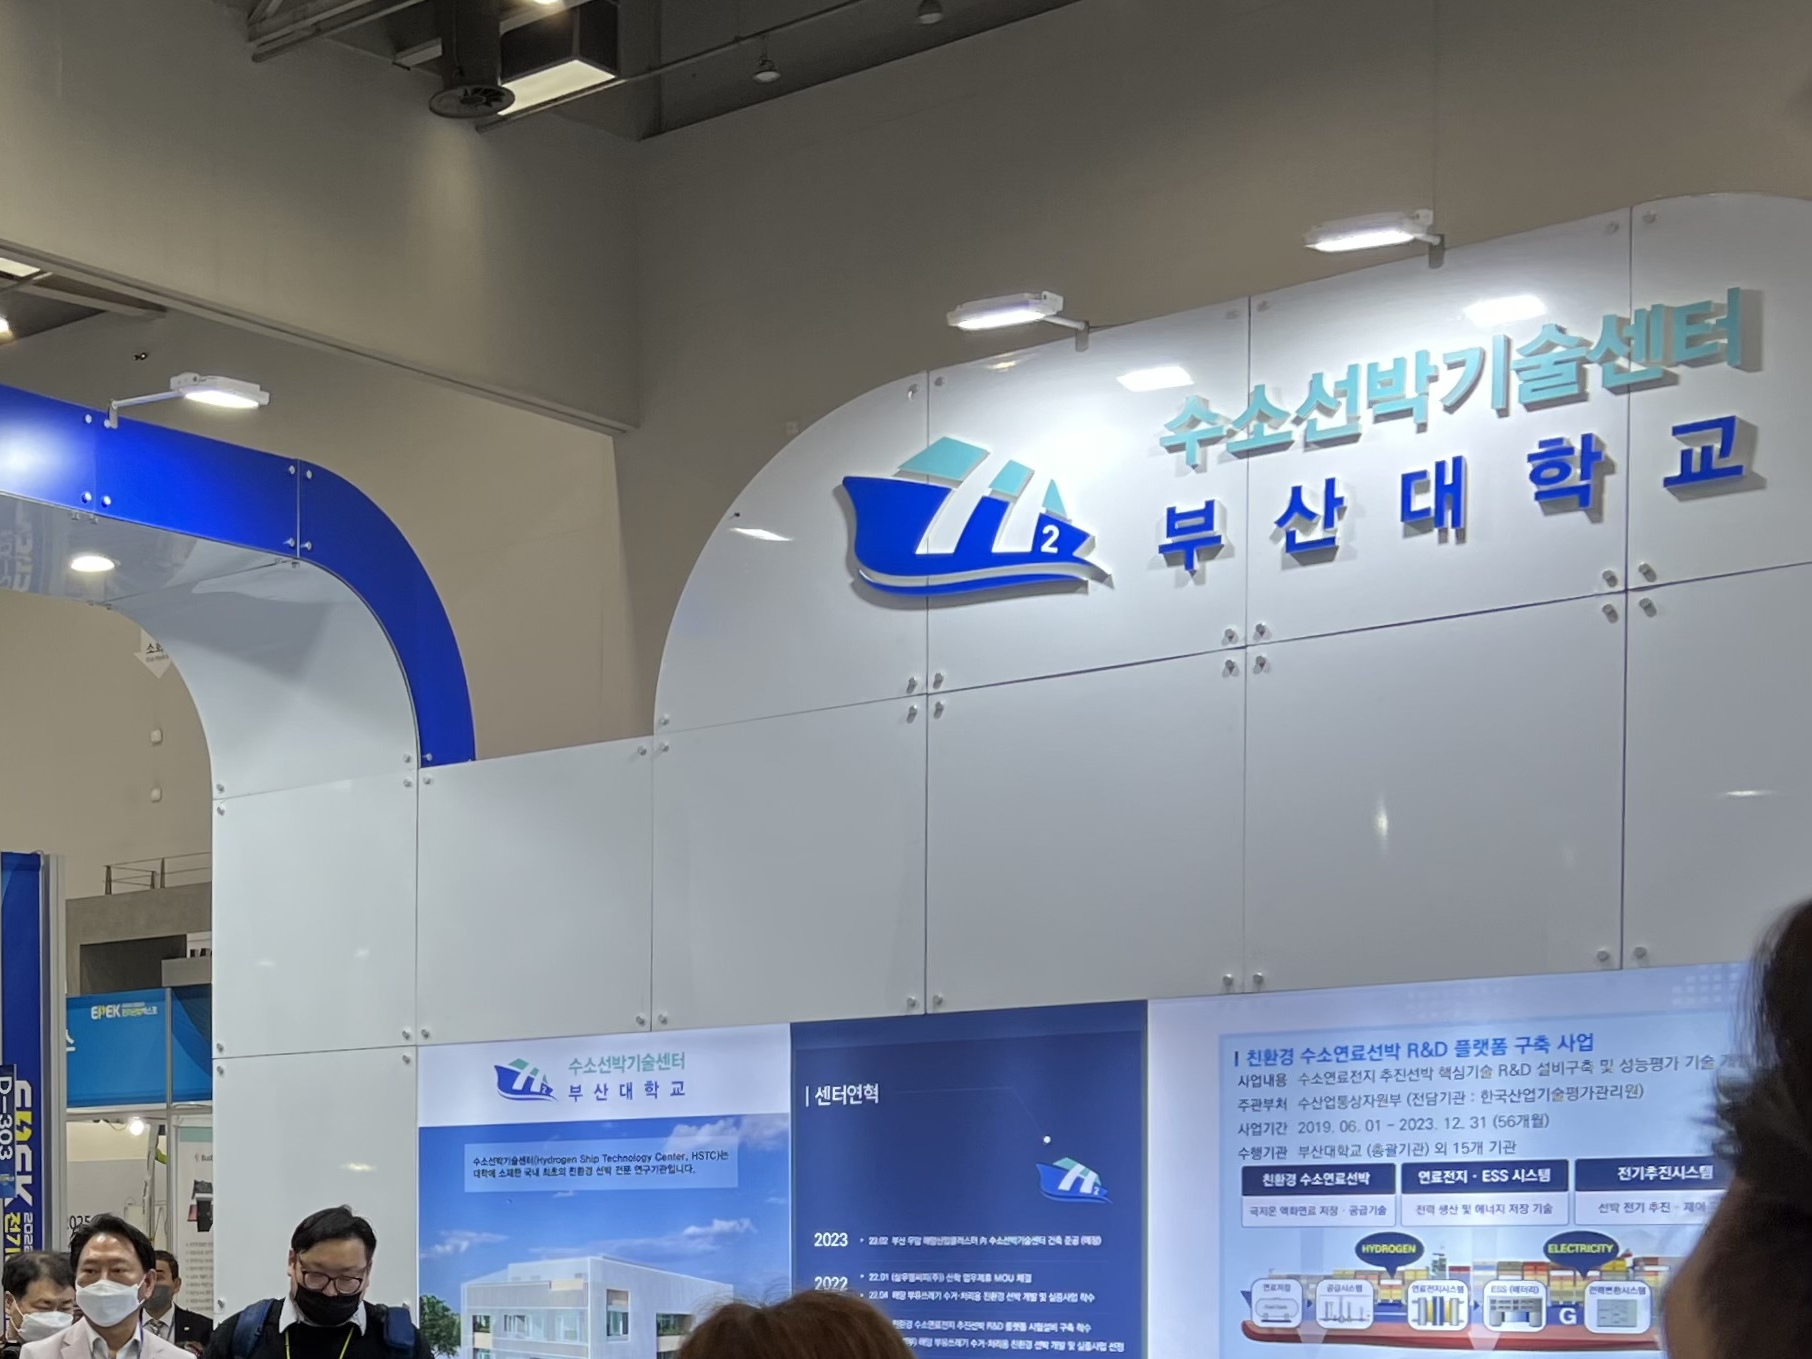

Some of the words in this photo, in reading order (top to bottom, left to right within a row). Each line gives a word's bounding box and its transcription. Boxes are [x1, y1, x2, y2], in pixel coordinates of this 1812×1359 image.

[1158, 286, 1743, 468] 수소선박기술센터
[1157, 415, 1745, 572] 부산대학교
[1246, 1047, 1295, 1067] 친환경
[1299, 1042, 1402, 1066] 수소연료선박
[1406, 1041, 1448, 1059] R&D
[1453, 1037, 1508, 1058] 플랫폼
[1514, 1034, 1551, 1055] 구축
[1557, 1032, 1594, 1052] 사업
[567, 1051, 686, 1077] 수소선박기술센터
[1237, 1072, 1288, 1088] 사업내용
[1297, 1069, 1376, 1087] 수소연료전지
[1379, 1066, 1435, 1083] 추진선박
[1438, 1064, 1494, 1081] 핵심기술
[1498, 1063, 1532, 1077] R&D
[1536, 1059, 1594, 1077] 설비구축
[1600, 1058, 1614, 1074] 및
[1619, 1055, 1679, 1074] 성능평가
[1684, 1054, 1716, 1071] 기술
[567, 1080, 686, 1102] 부산대학교
[814, 1082, 880, 1107] 센터연혁
[1237, 1097, 1288, 1113] 주관부처
[1297, 1093, 1402, 1111] 수산업통상자원부
[1406, 1091, 1466, 1108] (전담기관
[1480, 1082, 1645, 1104] 한국산업기술평가관리원)
[1237, 1121, 1288, 1137] 사업기간
[1297, 1120, 1335, 1135] 2019.
[1339, 1119, 1362, 1133] 06.
[1365, 1118, 1382, 1132] 01
[1399, 1117, 1437, 1131] 2023.
[1444, 1116, 1466, 1130] 12.
[1469, 1115, 1487, 1129] 31
[1492, 1112, 1550, 1129] (56개월)
[579, 1153, 600, 1165] Ship
[602, 1152, 652, 1164] Technology
[1237, 1145, 1288, 1161] 수행기관
[1297, 1143, 1362, 1160] 부산대학교
[1366, 1141, 1430, 1158] (총괄기관)
[1434, 1141, 1448, 1156] 외
[1453, 1139, 1484, 1156] 15개
[1489, 1139, 1517, 1155] 기관
[1262, 1172, 1297, 1188] 친환경
[1299, 1170, 1371, 1186] 수소연료선박
[1417, 1169, 1468, 1185] 연료전지
[1481, 1168, 1509, 1183] ESS
[1511, 1167, 1552, 1183] 시스템
[1616, 1164, 1715, 1182] 전기추진시스템
[4, 1212, 21, 1262] 전기
[813, 1231, 849, 1248] 2023
[1361, 1243, 1417, 1255] HYDROGEN
[1546, 1243, 1615, 1254] ELECTRICITY
[814, 1276, 849, 1291] 2022
[1558, 1307, 1578, 1325] G
